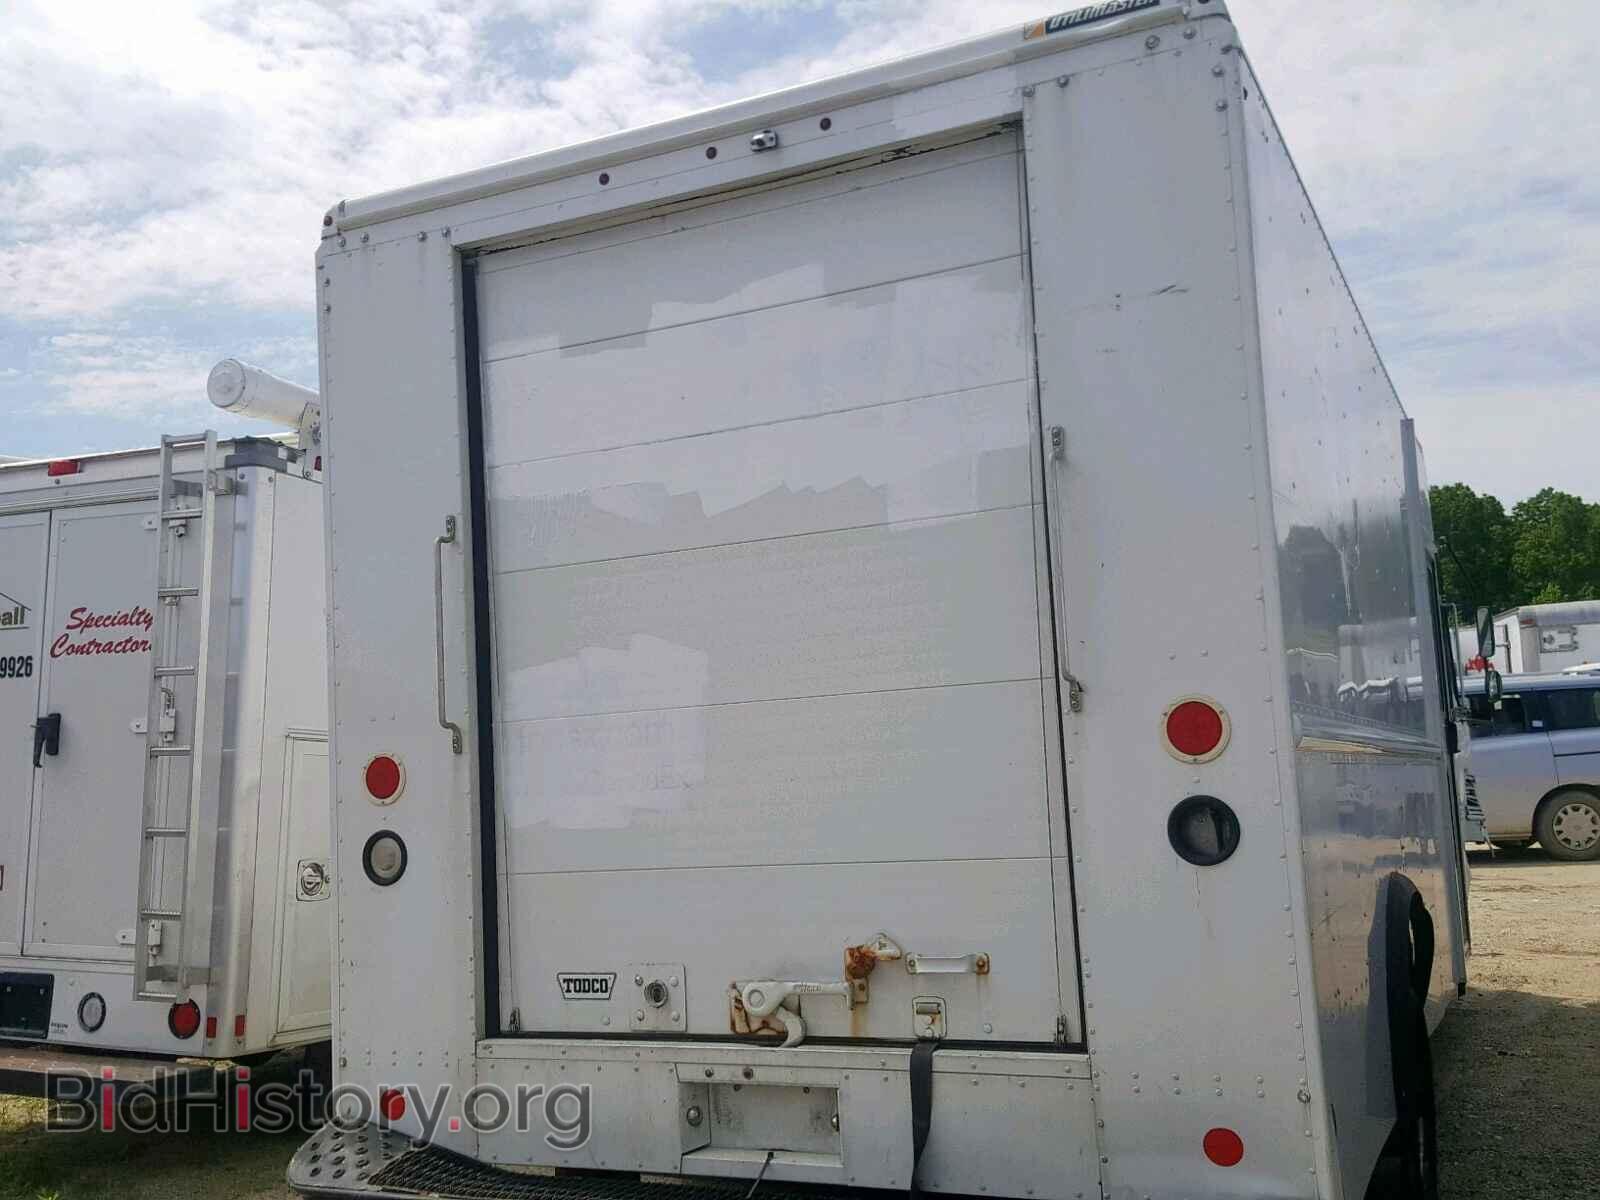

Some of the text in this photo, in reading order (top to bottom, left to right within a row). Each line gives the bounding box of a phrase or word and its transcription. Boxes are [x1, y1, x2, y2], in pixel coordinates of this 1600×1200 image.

[0, 606, 25, 626] all
[66, 606, 153, 634] Specialty
[50, 633, 151, 658] Contractor
[0, 655, 33, 679] 9926
[562, 978, 609, 994] TODCO
